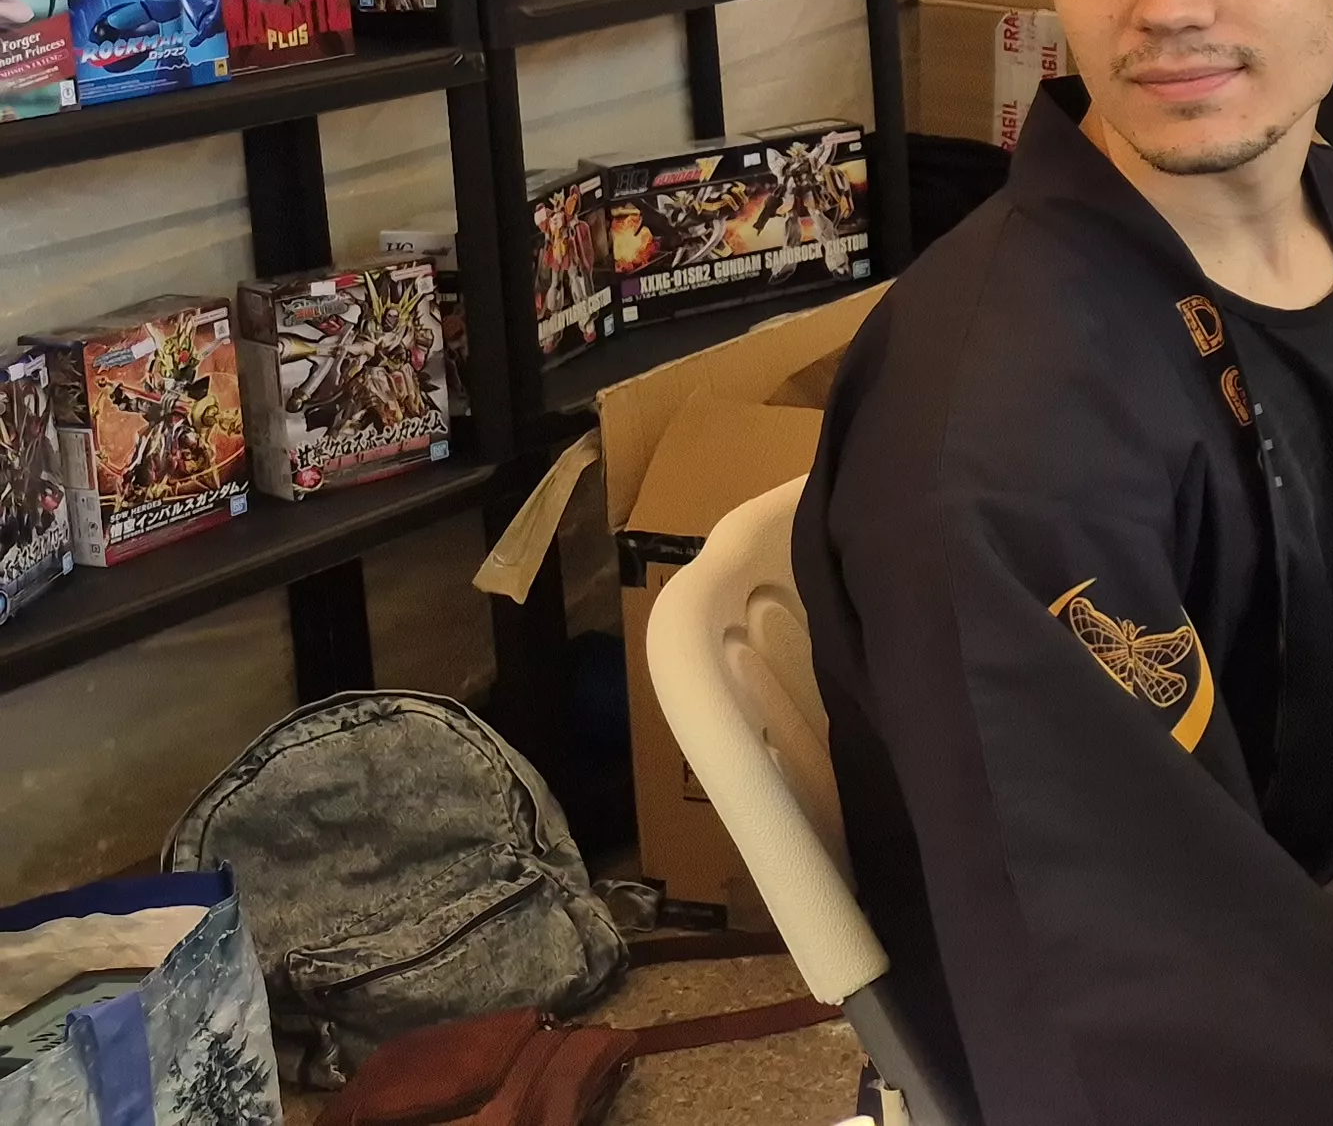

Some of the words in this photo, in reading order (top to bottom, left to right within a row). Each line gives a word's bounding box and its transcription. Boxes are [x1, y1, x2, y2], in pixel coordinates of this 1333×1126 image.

[267, 23, 309, 51] PLUS
[1003, 10, 1021, 53] FRA
[25, 38, 66, 60] Princess
[82, 32, 188, 64] ROCKMAN
[149, 47, 187, 61] ロックマン
[1042, 42, 1059, 80] AGIL
[1001, 100, 1018, 154] RAGIL
[715, 254, 762, 279] GUNDAM
[765, 243, 823, 270] SANDROCK
[826, 232, 869, 256] CUSTOM
[131, 500, 162, 517] HEROES
